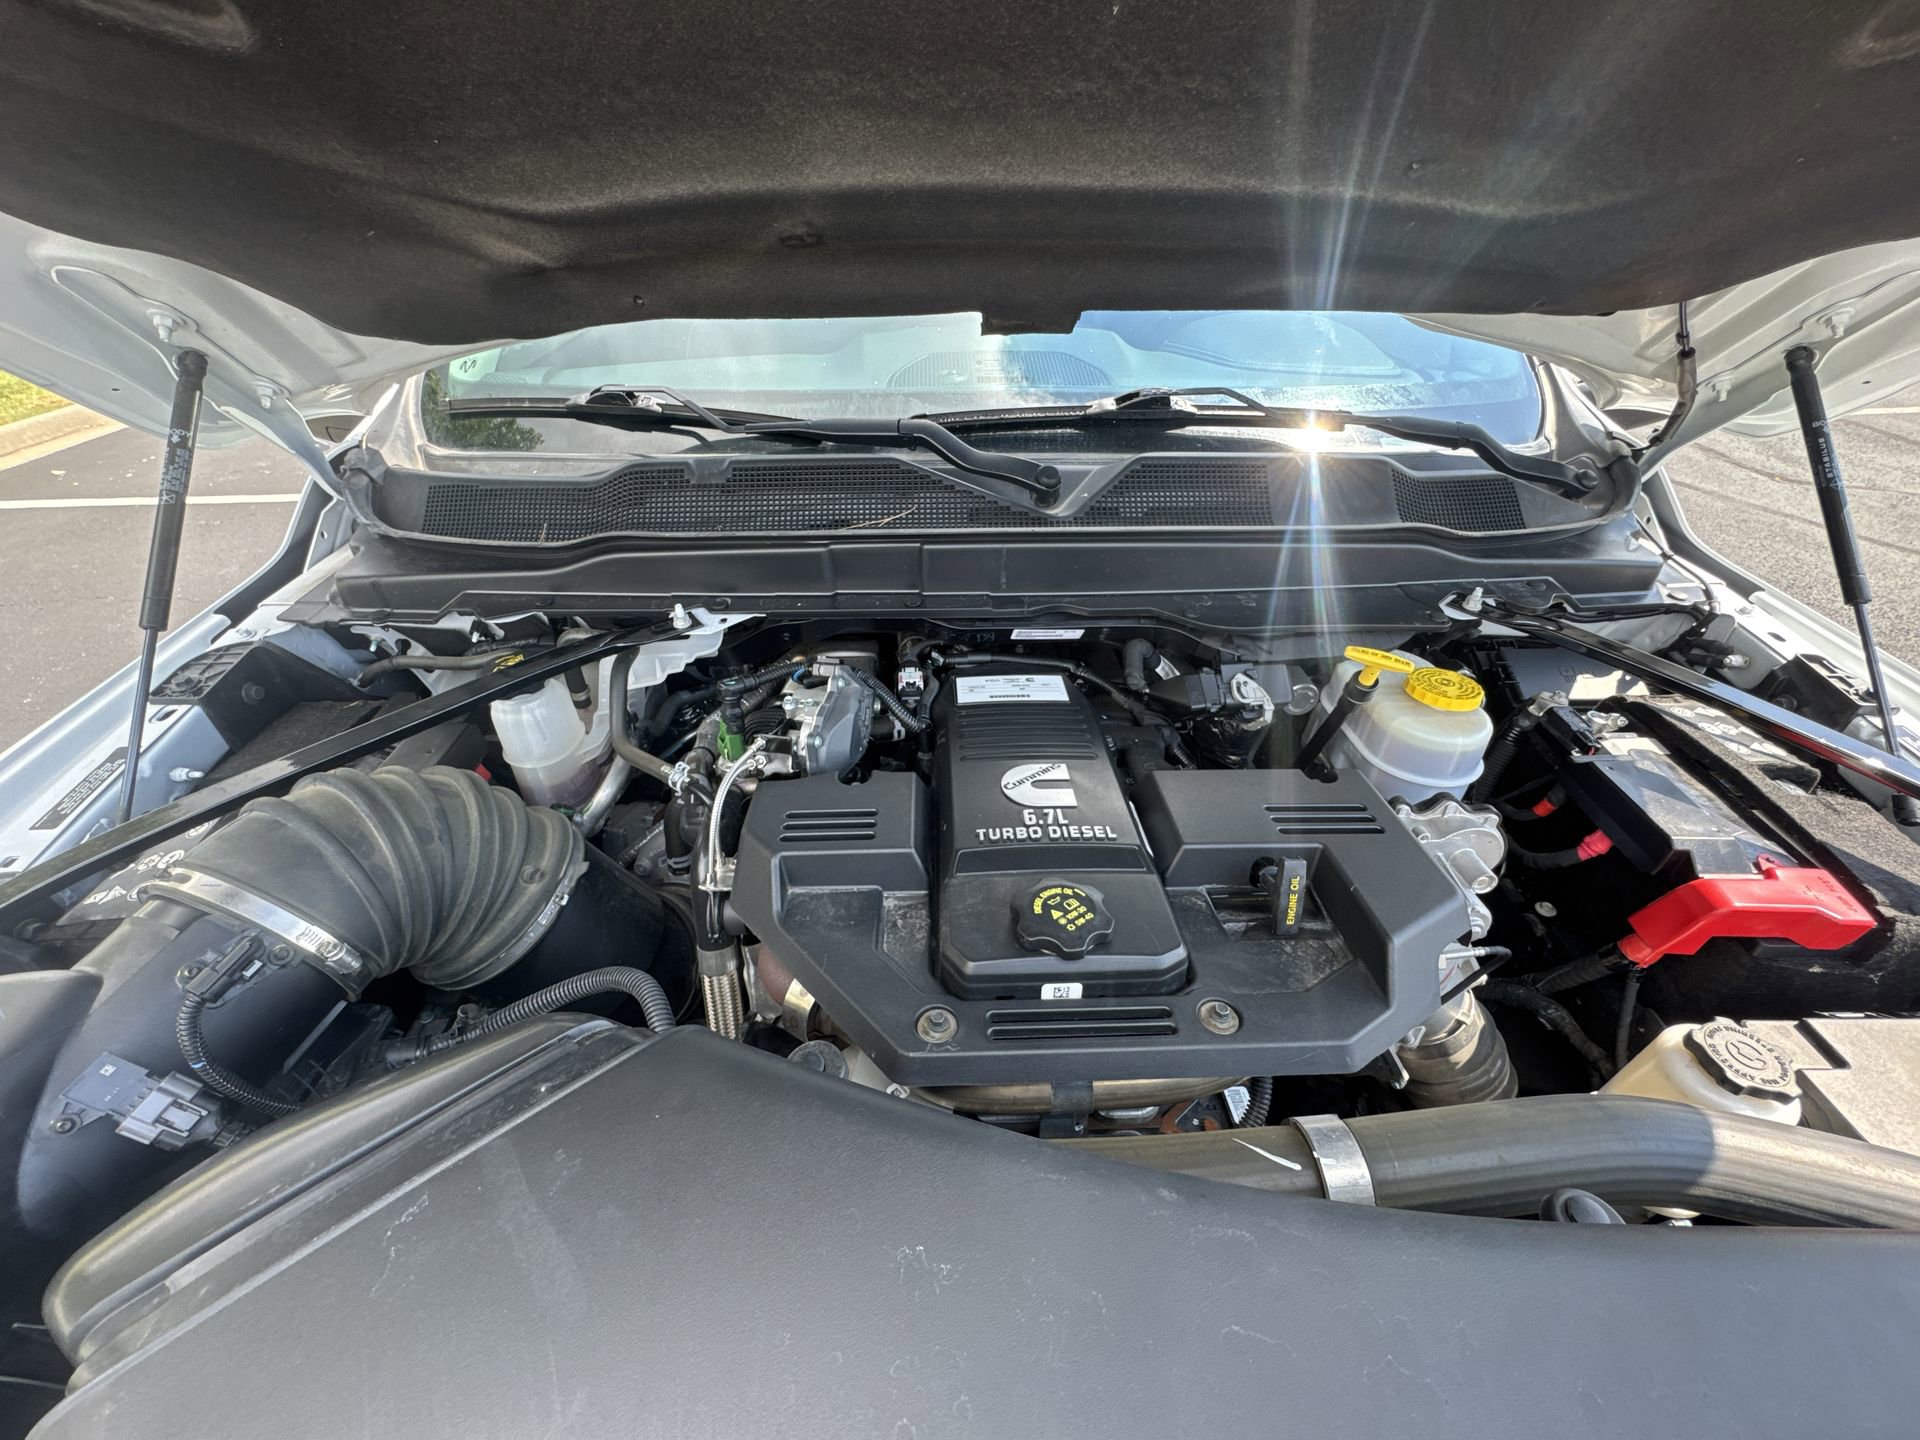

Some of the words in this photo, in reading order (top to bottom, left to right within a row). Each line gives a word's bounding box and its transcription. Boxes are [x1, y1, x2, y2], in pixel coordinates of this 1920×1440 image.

[1818, 437, 1834, 478] STABILUS
[1003, 763, 1061, 791] Cummins
[1022, 808, 1069, 825] 6.7L
[976, 826, 1042, 841] TURBO
[1048, 825, 1118, 839] DIESEL
[1063, 887, 1074, 896] OIL
[1290, 876, 1300, 891] OIL
[1286, 893, 1298, 925] ENGINE
